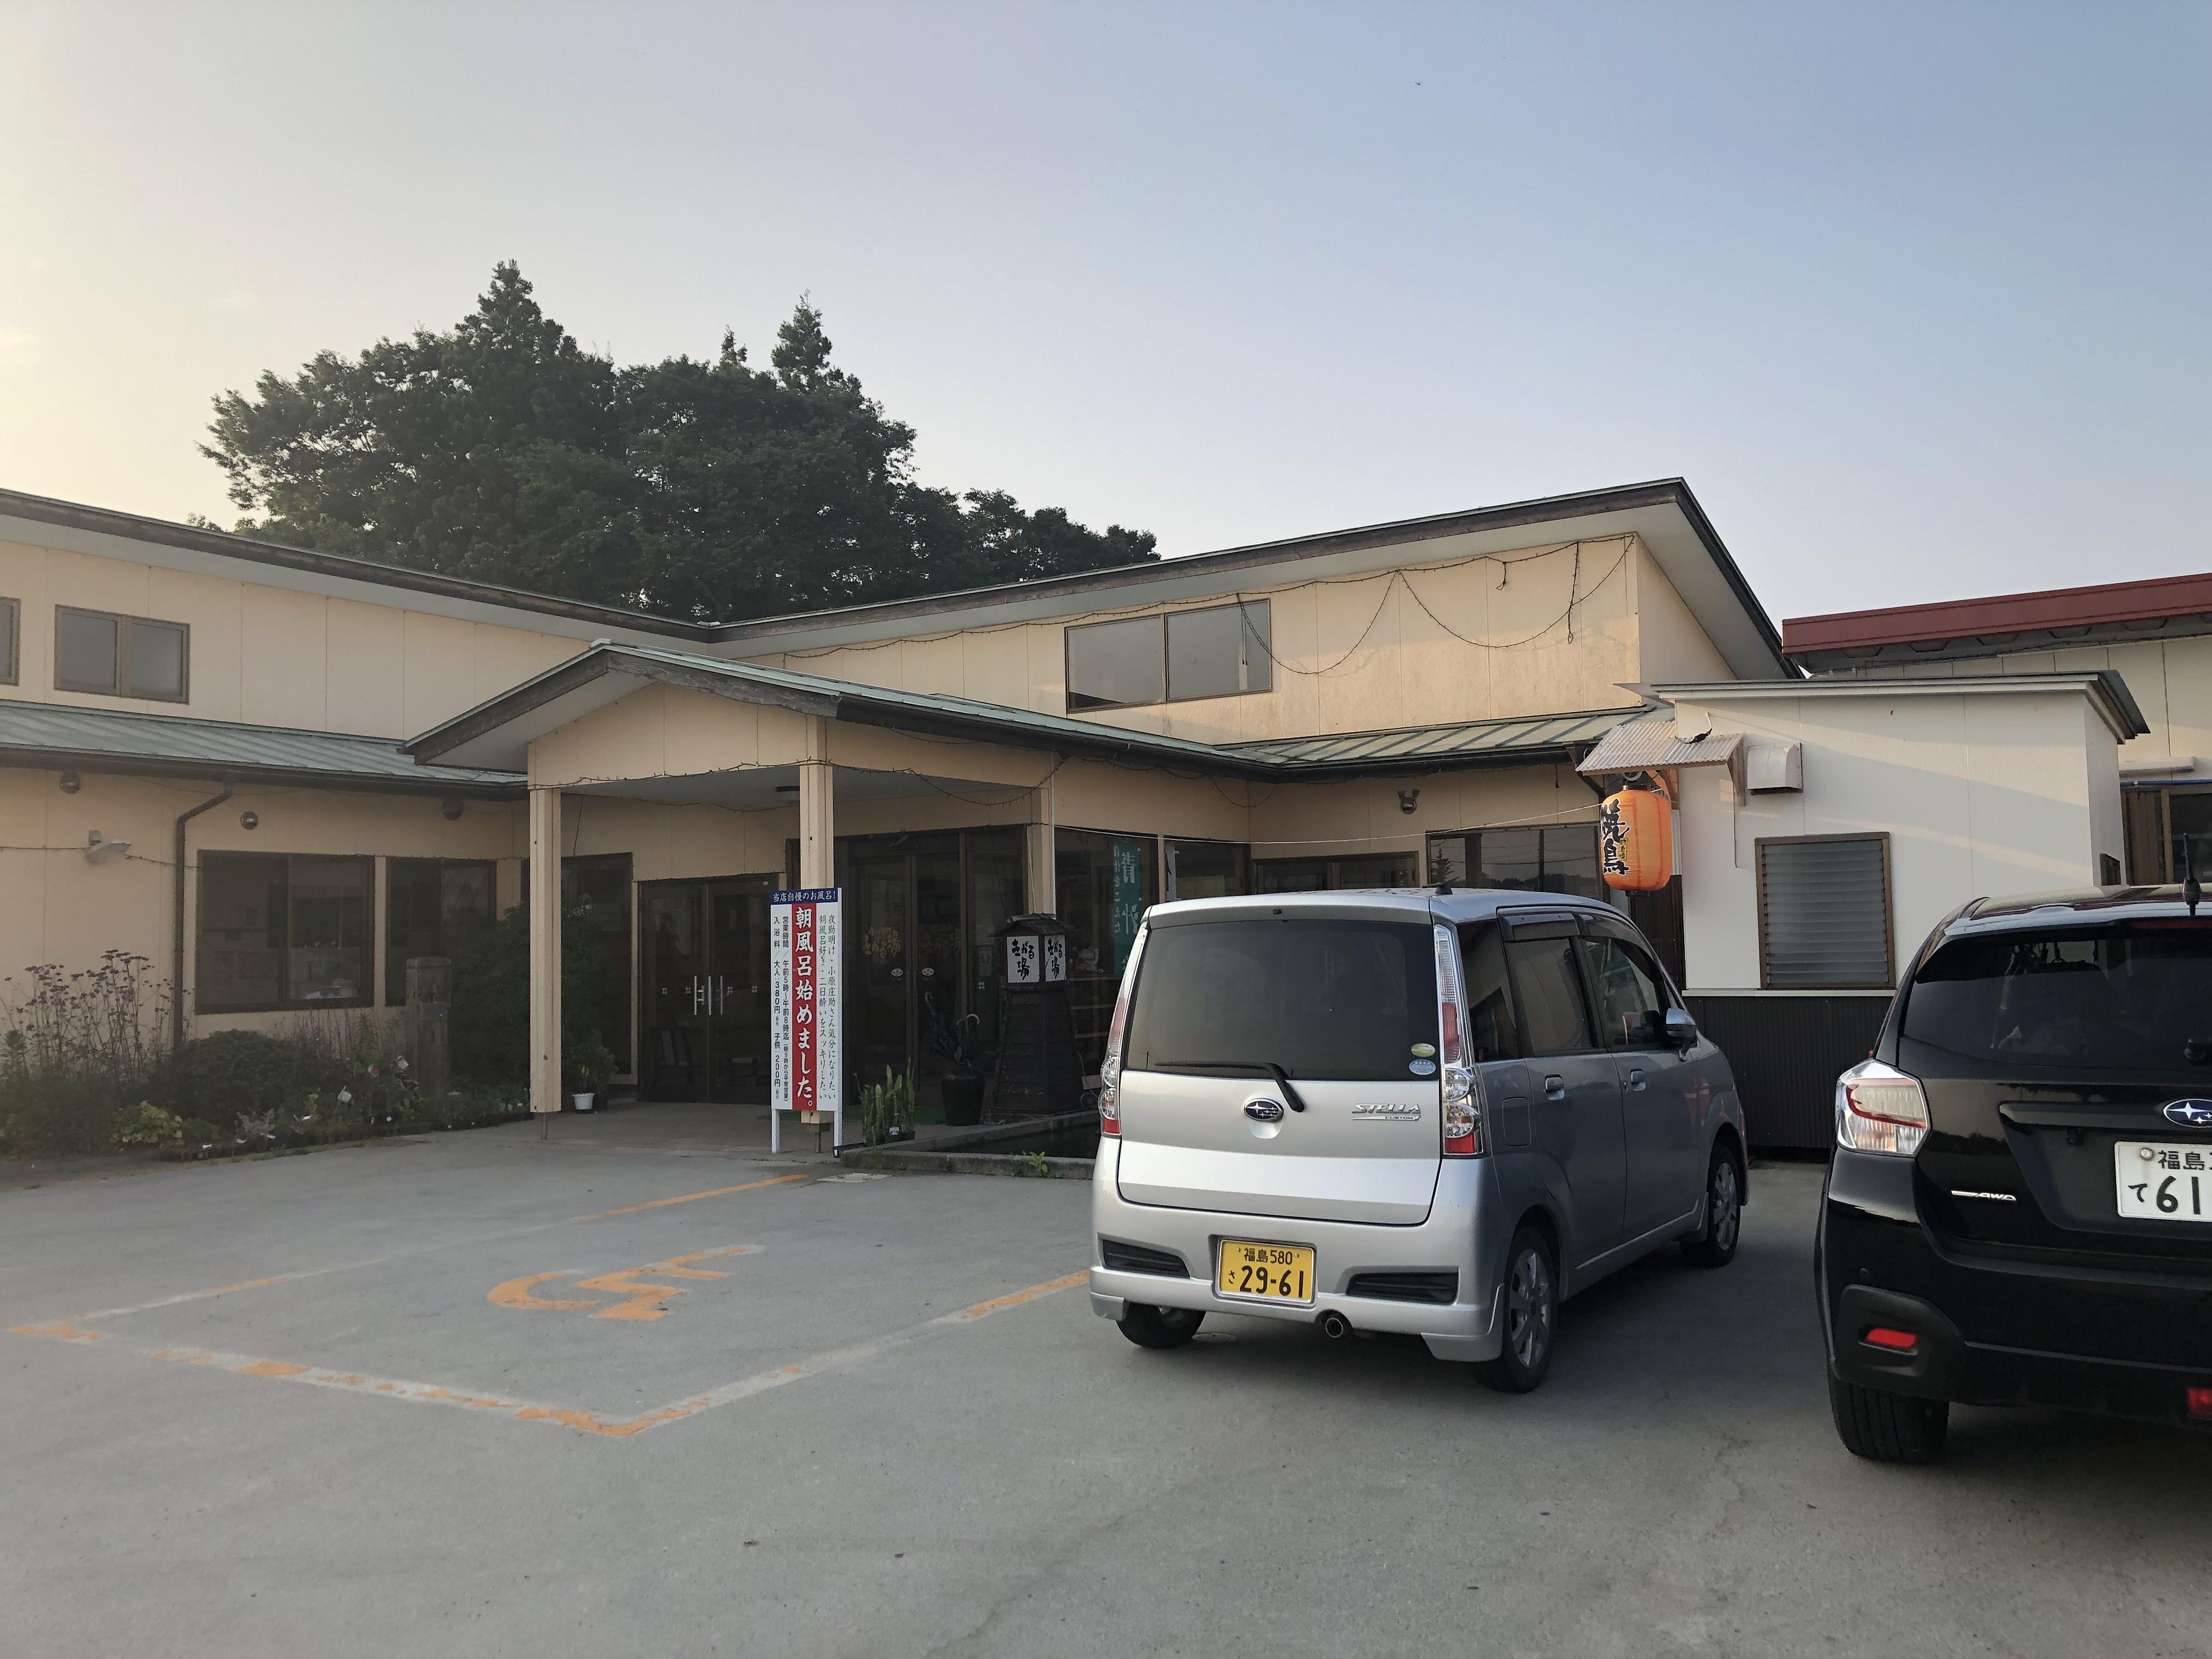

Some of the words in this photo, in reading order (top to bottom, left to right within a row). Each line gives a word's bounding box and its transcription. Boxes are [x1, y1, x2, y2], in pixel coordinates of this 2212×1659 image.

[795, 907, 814, 1108] 朝風呂始めました。
[1352, 1103, 1421, 1114] STELLA
[2158, 1150, 2212, 1171] 福島
[2128, 1183, 2148, 1203] て
[2156, 1176, 2201, 1215] 61
[1228, 1270, 1235, 1284] さ
[1239, 1265, 1304, 1298] 29-61
